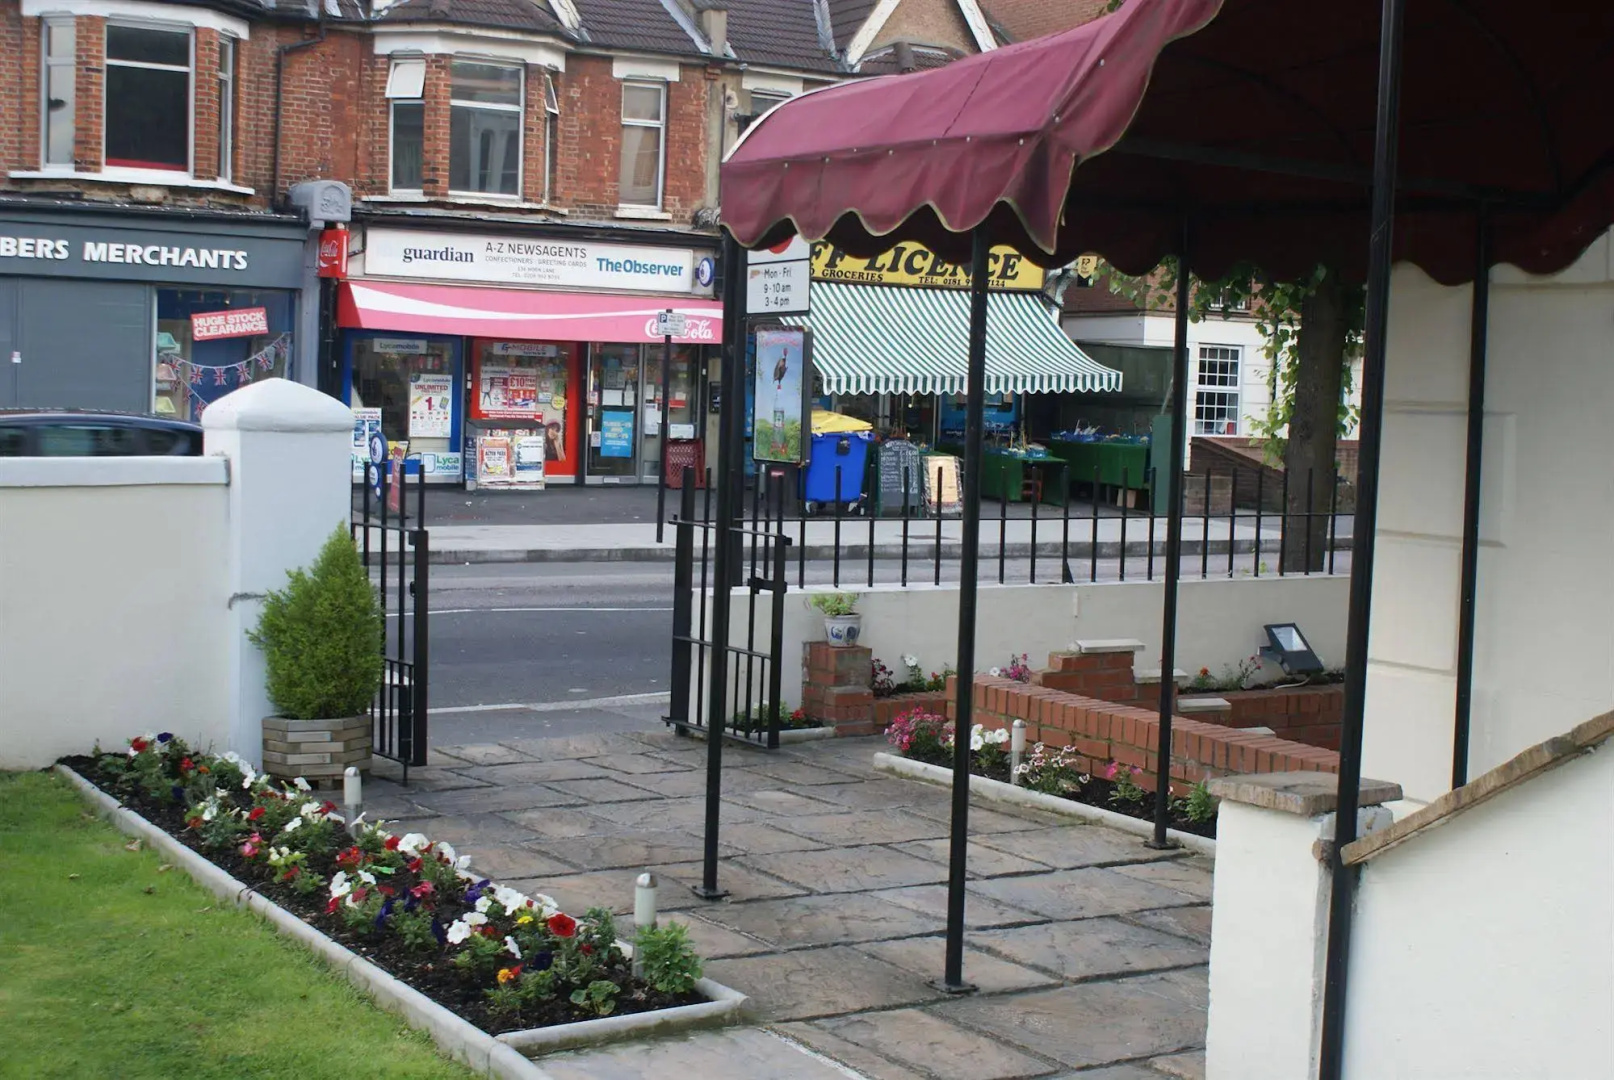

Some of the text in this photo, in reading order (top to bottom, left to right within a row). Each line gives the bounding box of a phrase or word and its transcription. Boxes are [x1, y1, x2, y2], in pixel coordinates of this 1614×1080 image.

[0, 237, 248, 270] BERS MERCHANTS
[402, 247, 475, 263] guardian
[485, 242, 587, 258] A-Z NEWSAGENTS
[485, 255, 587, 268] CONFECTIONERS GREETING CARDS
[821, 268, 883, 282] GROCERIES
[919, 276, 938, 285] TEL:
[943, 278, 961, 286] 0181
[194, 312, 264, 327] HUGE STOCK
[194, 321, 267, 336] CLEARANCE
[510, 377, 525, 388] £10
[436, 456, 460, 465] Lyca
